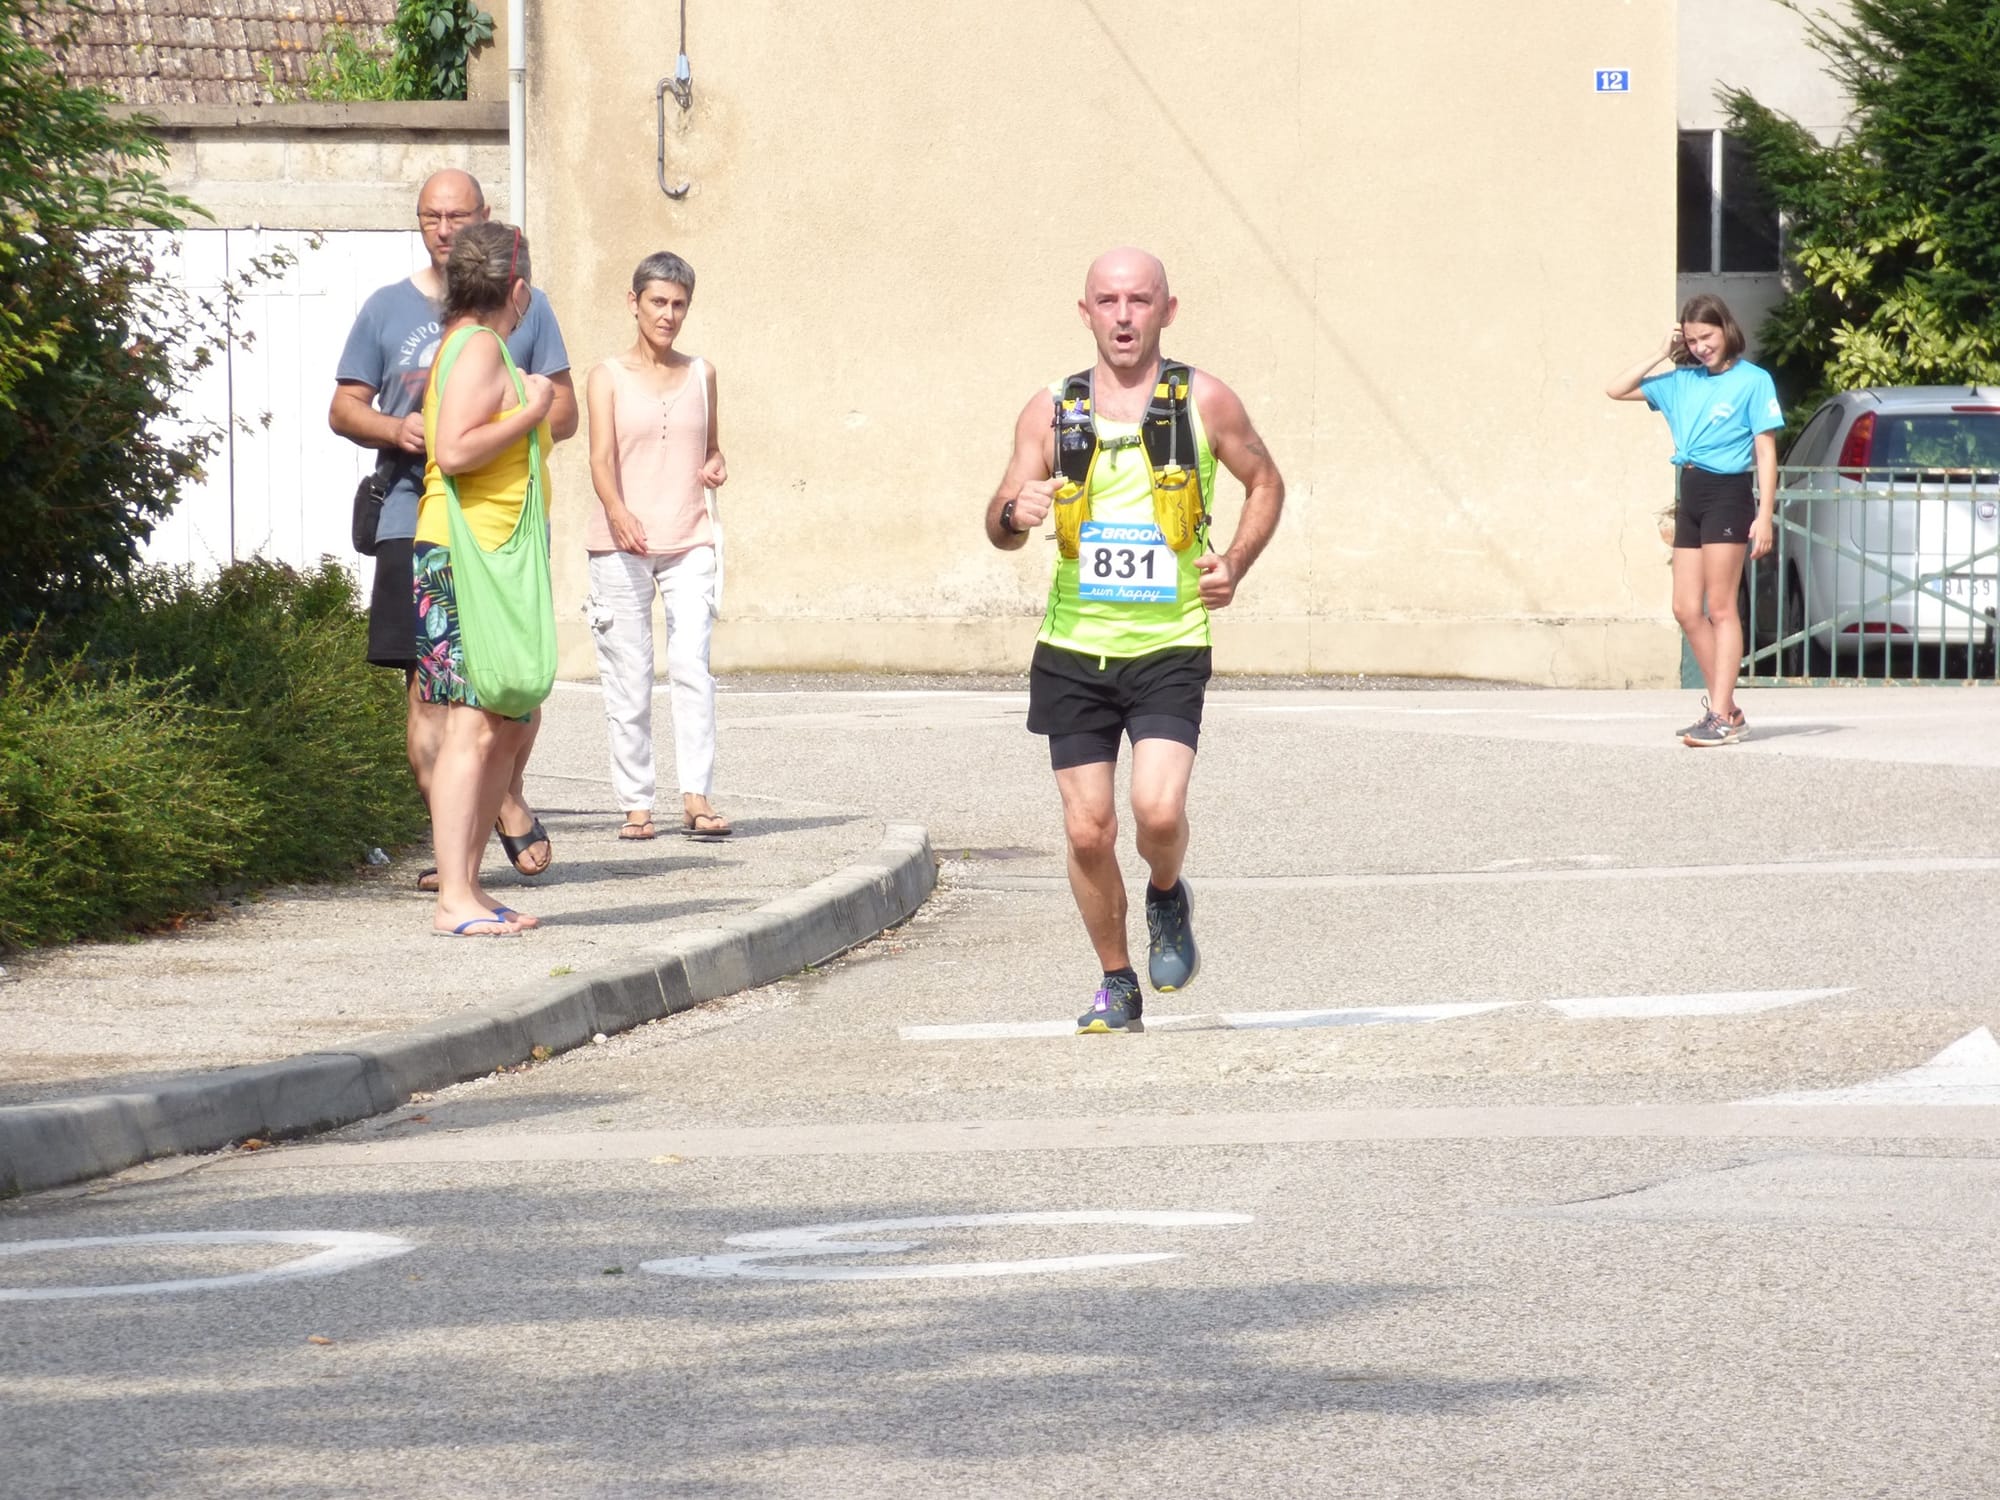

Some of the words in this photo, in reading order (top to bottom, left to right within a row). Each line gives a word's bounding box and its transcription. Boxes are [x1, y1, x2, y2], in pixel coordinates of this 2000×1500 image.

[1601, 72, 1623, 90] 12
[1094, 547, 1155, 580] 831
[1116, 585, 1161, 602] happy
